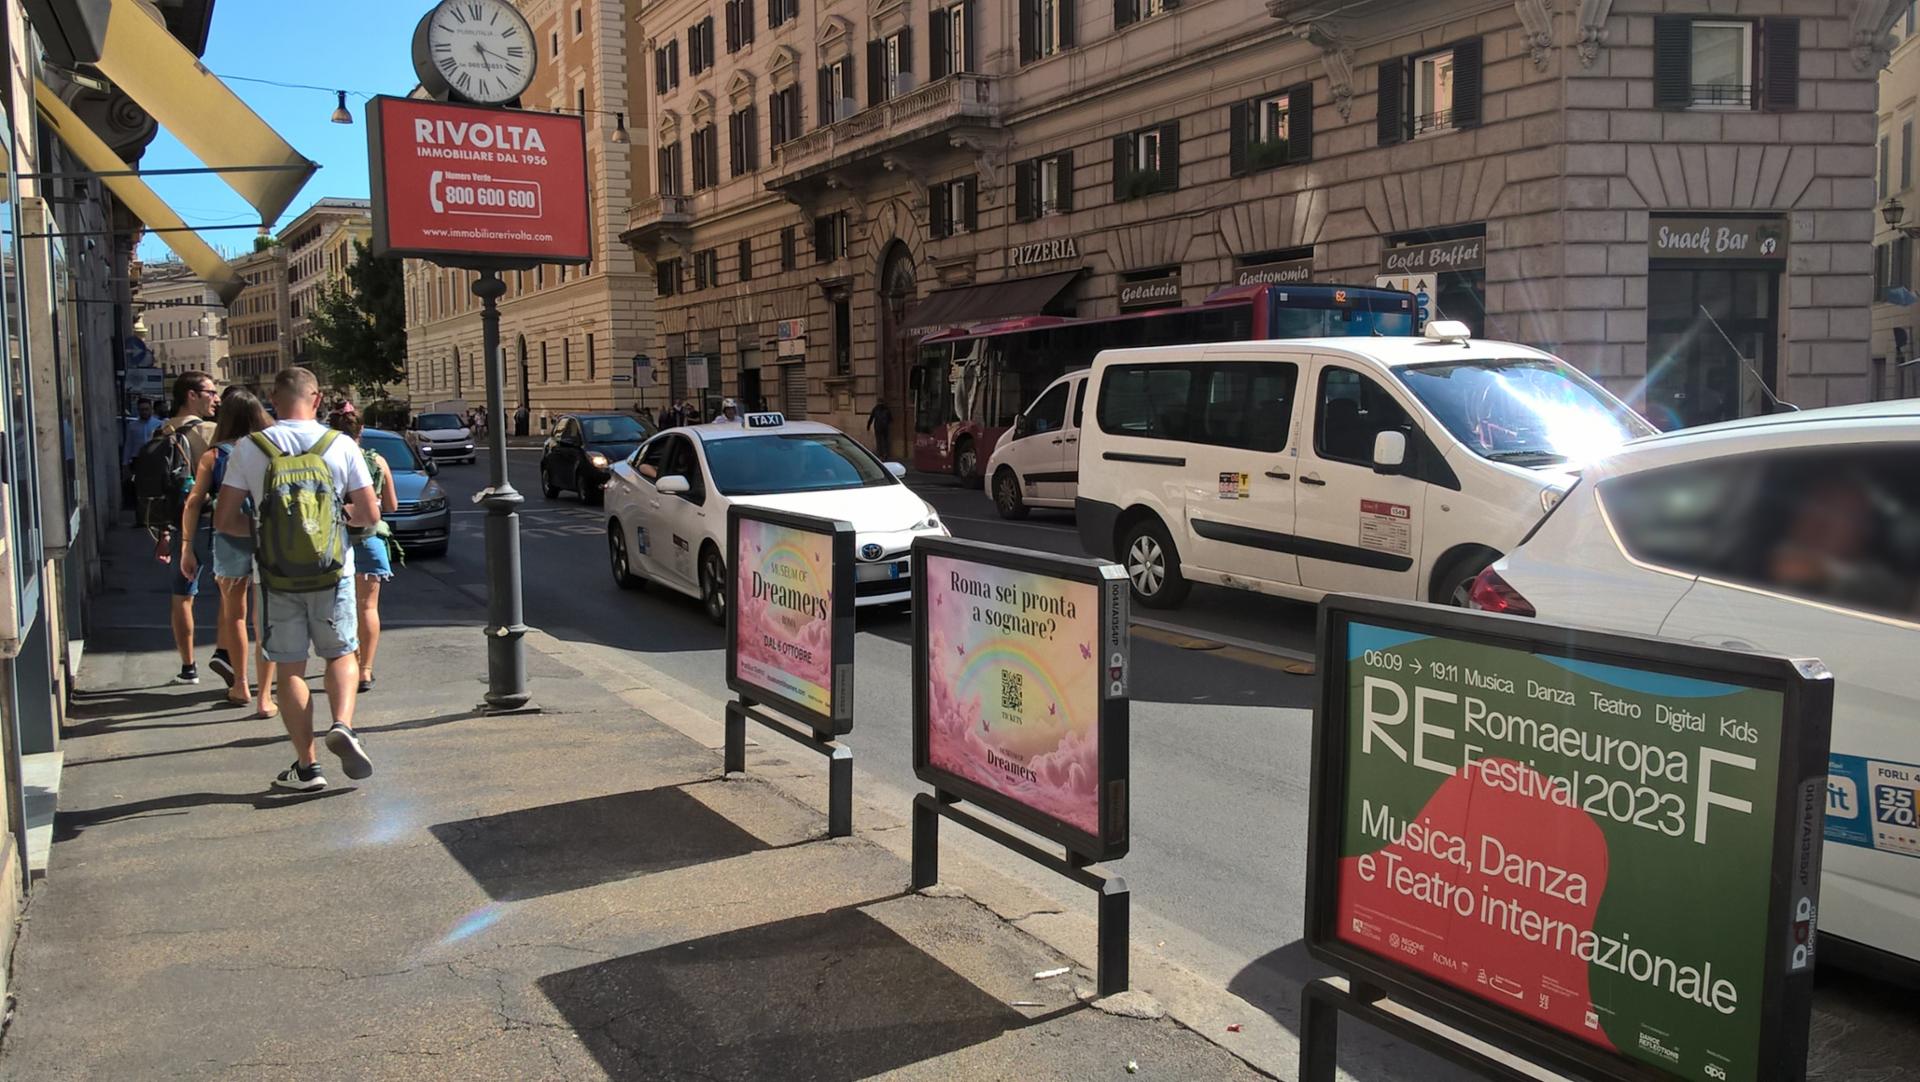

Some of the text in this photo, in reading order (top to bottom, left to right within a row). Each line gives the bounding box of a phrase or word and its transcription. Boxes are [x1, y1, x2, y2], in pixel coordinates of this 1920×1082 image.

[414, 118, 546, 152] RIVOLTA
[417, 147, 548, 166] IMMOBILIARE DAL 1956
[445, 186, 536, 209] 800 600 600
[422, 228, 553, 242] www.immobiliarerivolta.com
[1657, 225, 1750, 254] Snack Bar
[1011, 238, 1077, 266] PIZZERIA
[1386, 242, 1480, 270] Cold Buffet
[1239, 264, 1310, 286] Gastronomia
[1121, 282, 1178, 304] Gelateria
[1335, 290, 1347, 303] 62
[752, 415, 781, 427] TAXI
[771, 562, 808, 583] MUSEUM OF
[752, 571, 827, 621] Dreamers
[950, 571, 1077, 620] Roma sei pronta
[972, 606, 1056, 641] a sognare?
[763, 635, 777, 650] DAL
[782, 642, 813, 664] OTTOBRE
[1364, 649, 1758, 744] 06.09 19.11 Musica Danza Teatro Digital Kids
[1362, 675, 1458, 777] RE
[1465, 696, 1688, 784] Romaeuropa
[987, 749, 1037, 783] Dreamers
[1878, 767, 1909, 782] FORLI
[1463, 743, 1686, 837] Festival 2023
[1693, 746, 1757, 845] F
[1879, 786, 1913, 808] 35
[1879, 803, 1916, 826] 70.
[1361, 799, 1589, 906] Musica, Danza
[1357, 854, 1376, 881] e
[1380, 850, 1475, 917] Teatro
[1480, 885, 1738, 1015] internazionale
[1791, 896, 1812, 970] apa
[1432, 952, 1457, 970] ROMA
[1704, 1065, 1726, 1081] apa
